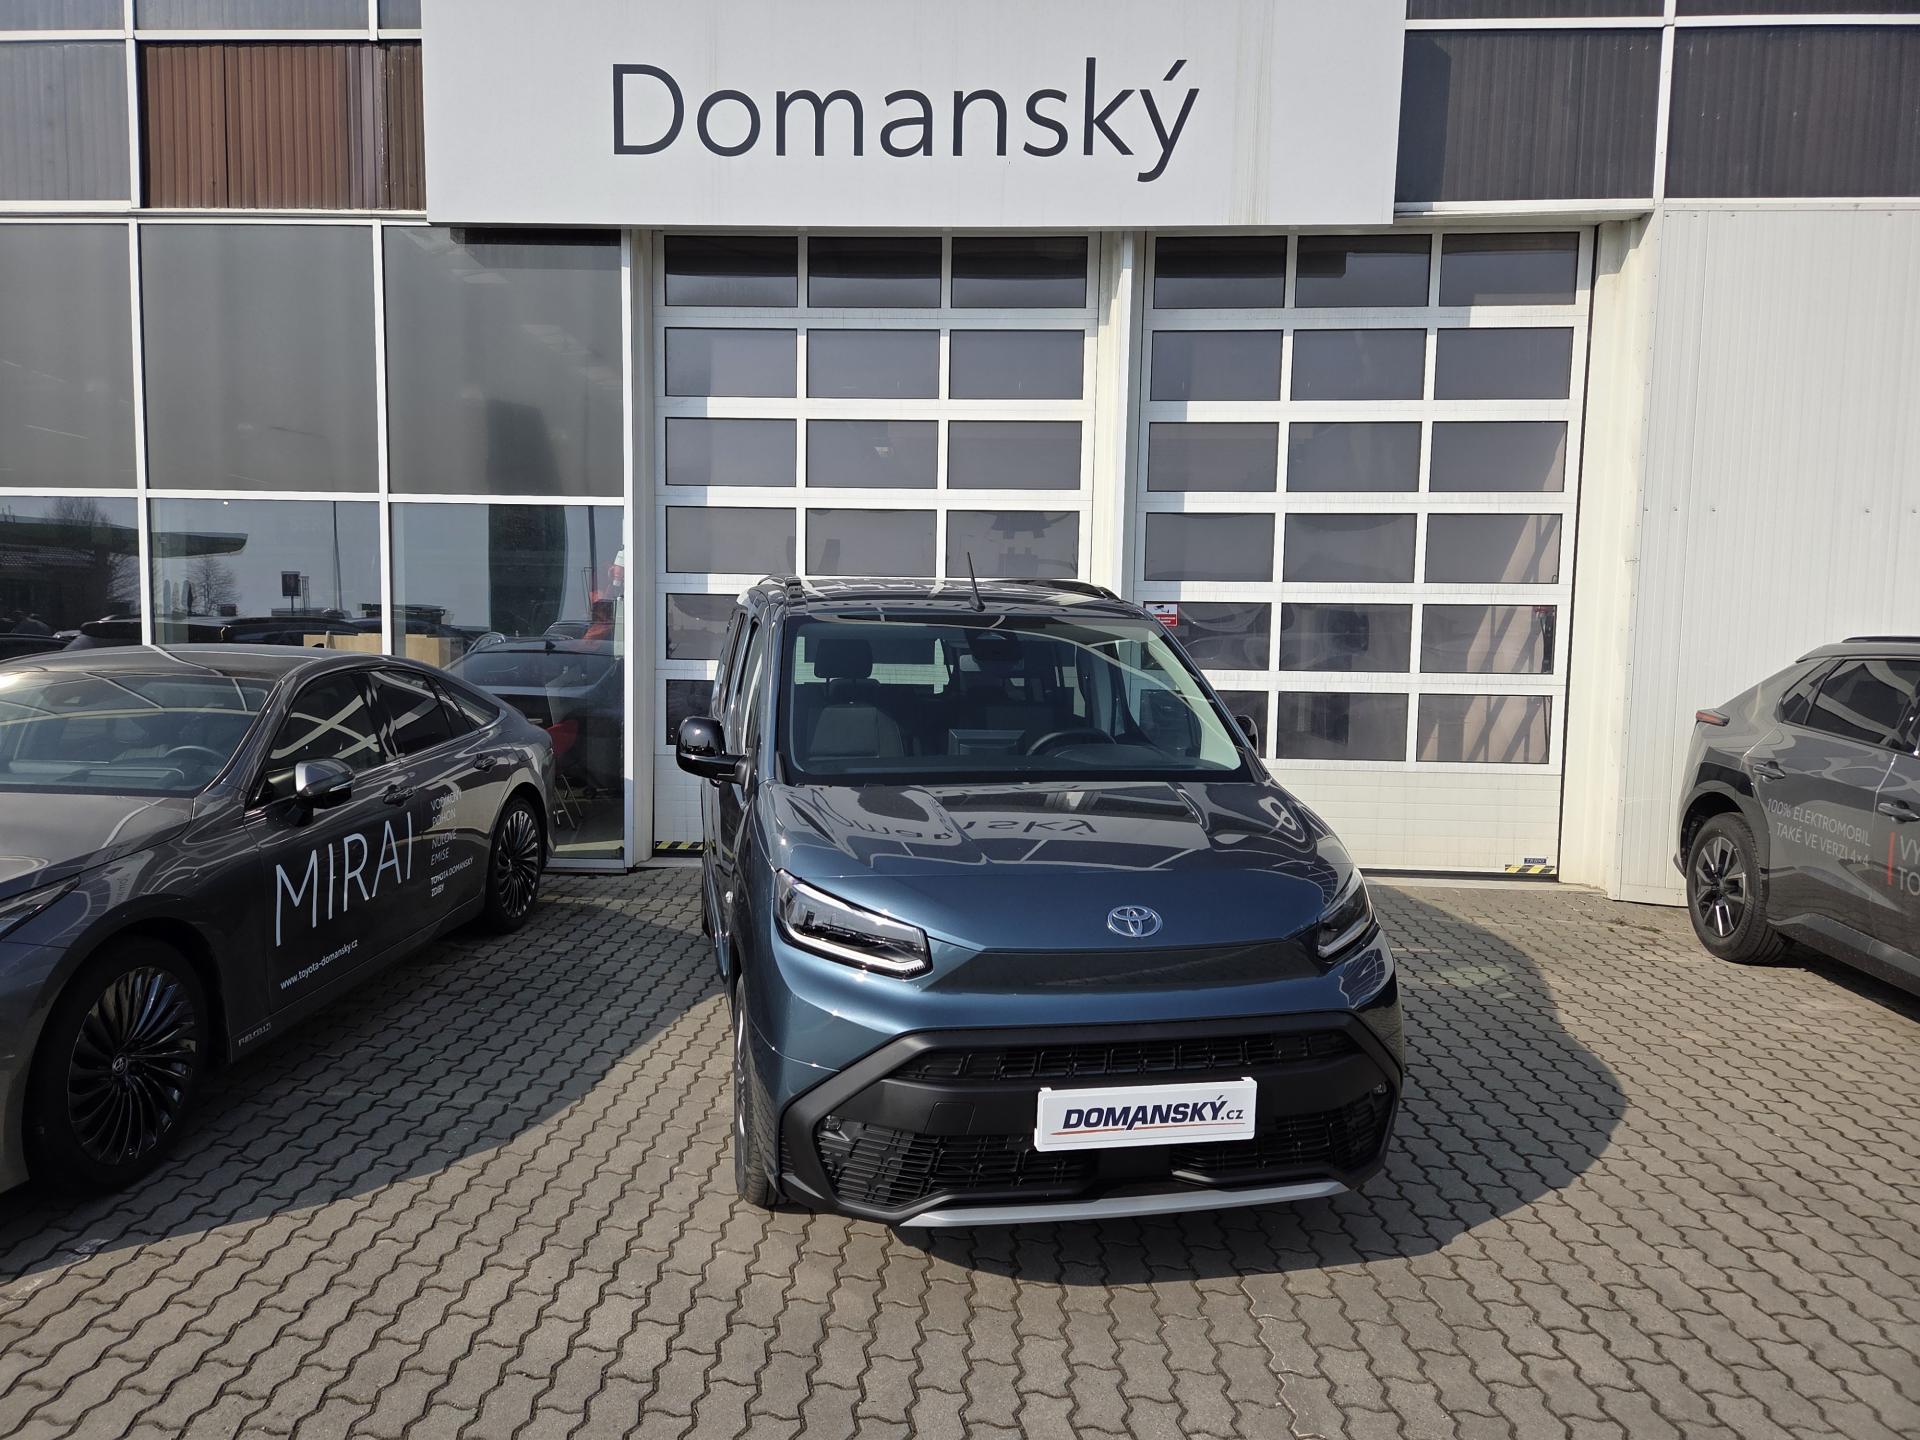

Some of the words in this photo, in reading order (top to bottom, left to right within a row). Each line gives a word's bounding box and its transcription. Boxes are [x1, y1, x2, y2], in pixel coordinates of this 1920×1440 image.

[612, 56, 1200, 183] Domanský
[1767, 798, 1791, 817] 100%
[1793, 806, 1871, 847] ELEKTROMOBIL
[1776, 822, 1802, 843] TAKÉ
[1804, 831, 1818, 849] VE
[1820, 836, 1849, 859] VERZI
[276, 811, 412, 947] MIRAI
[430, 847, 450, 866] EMISE
[431, 869, 449, 885] TOYOTA
[280, 939, 358, 990] www.toyota-domansky.cz
